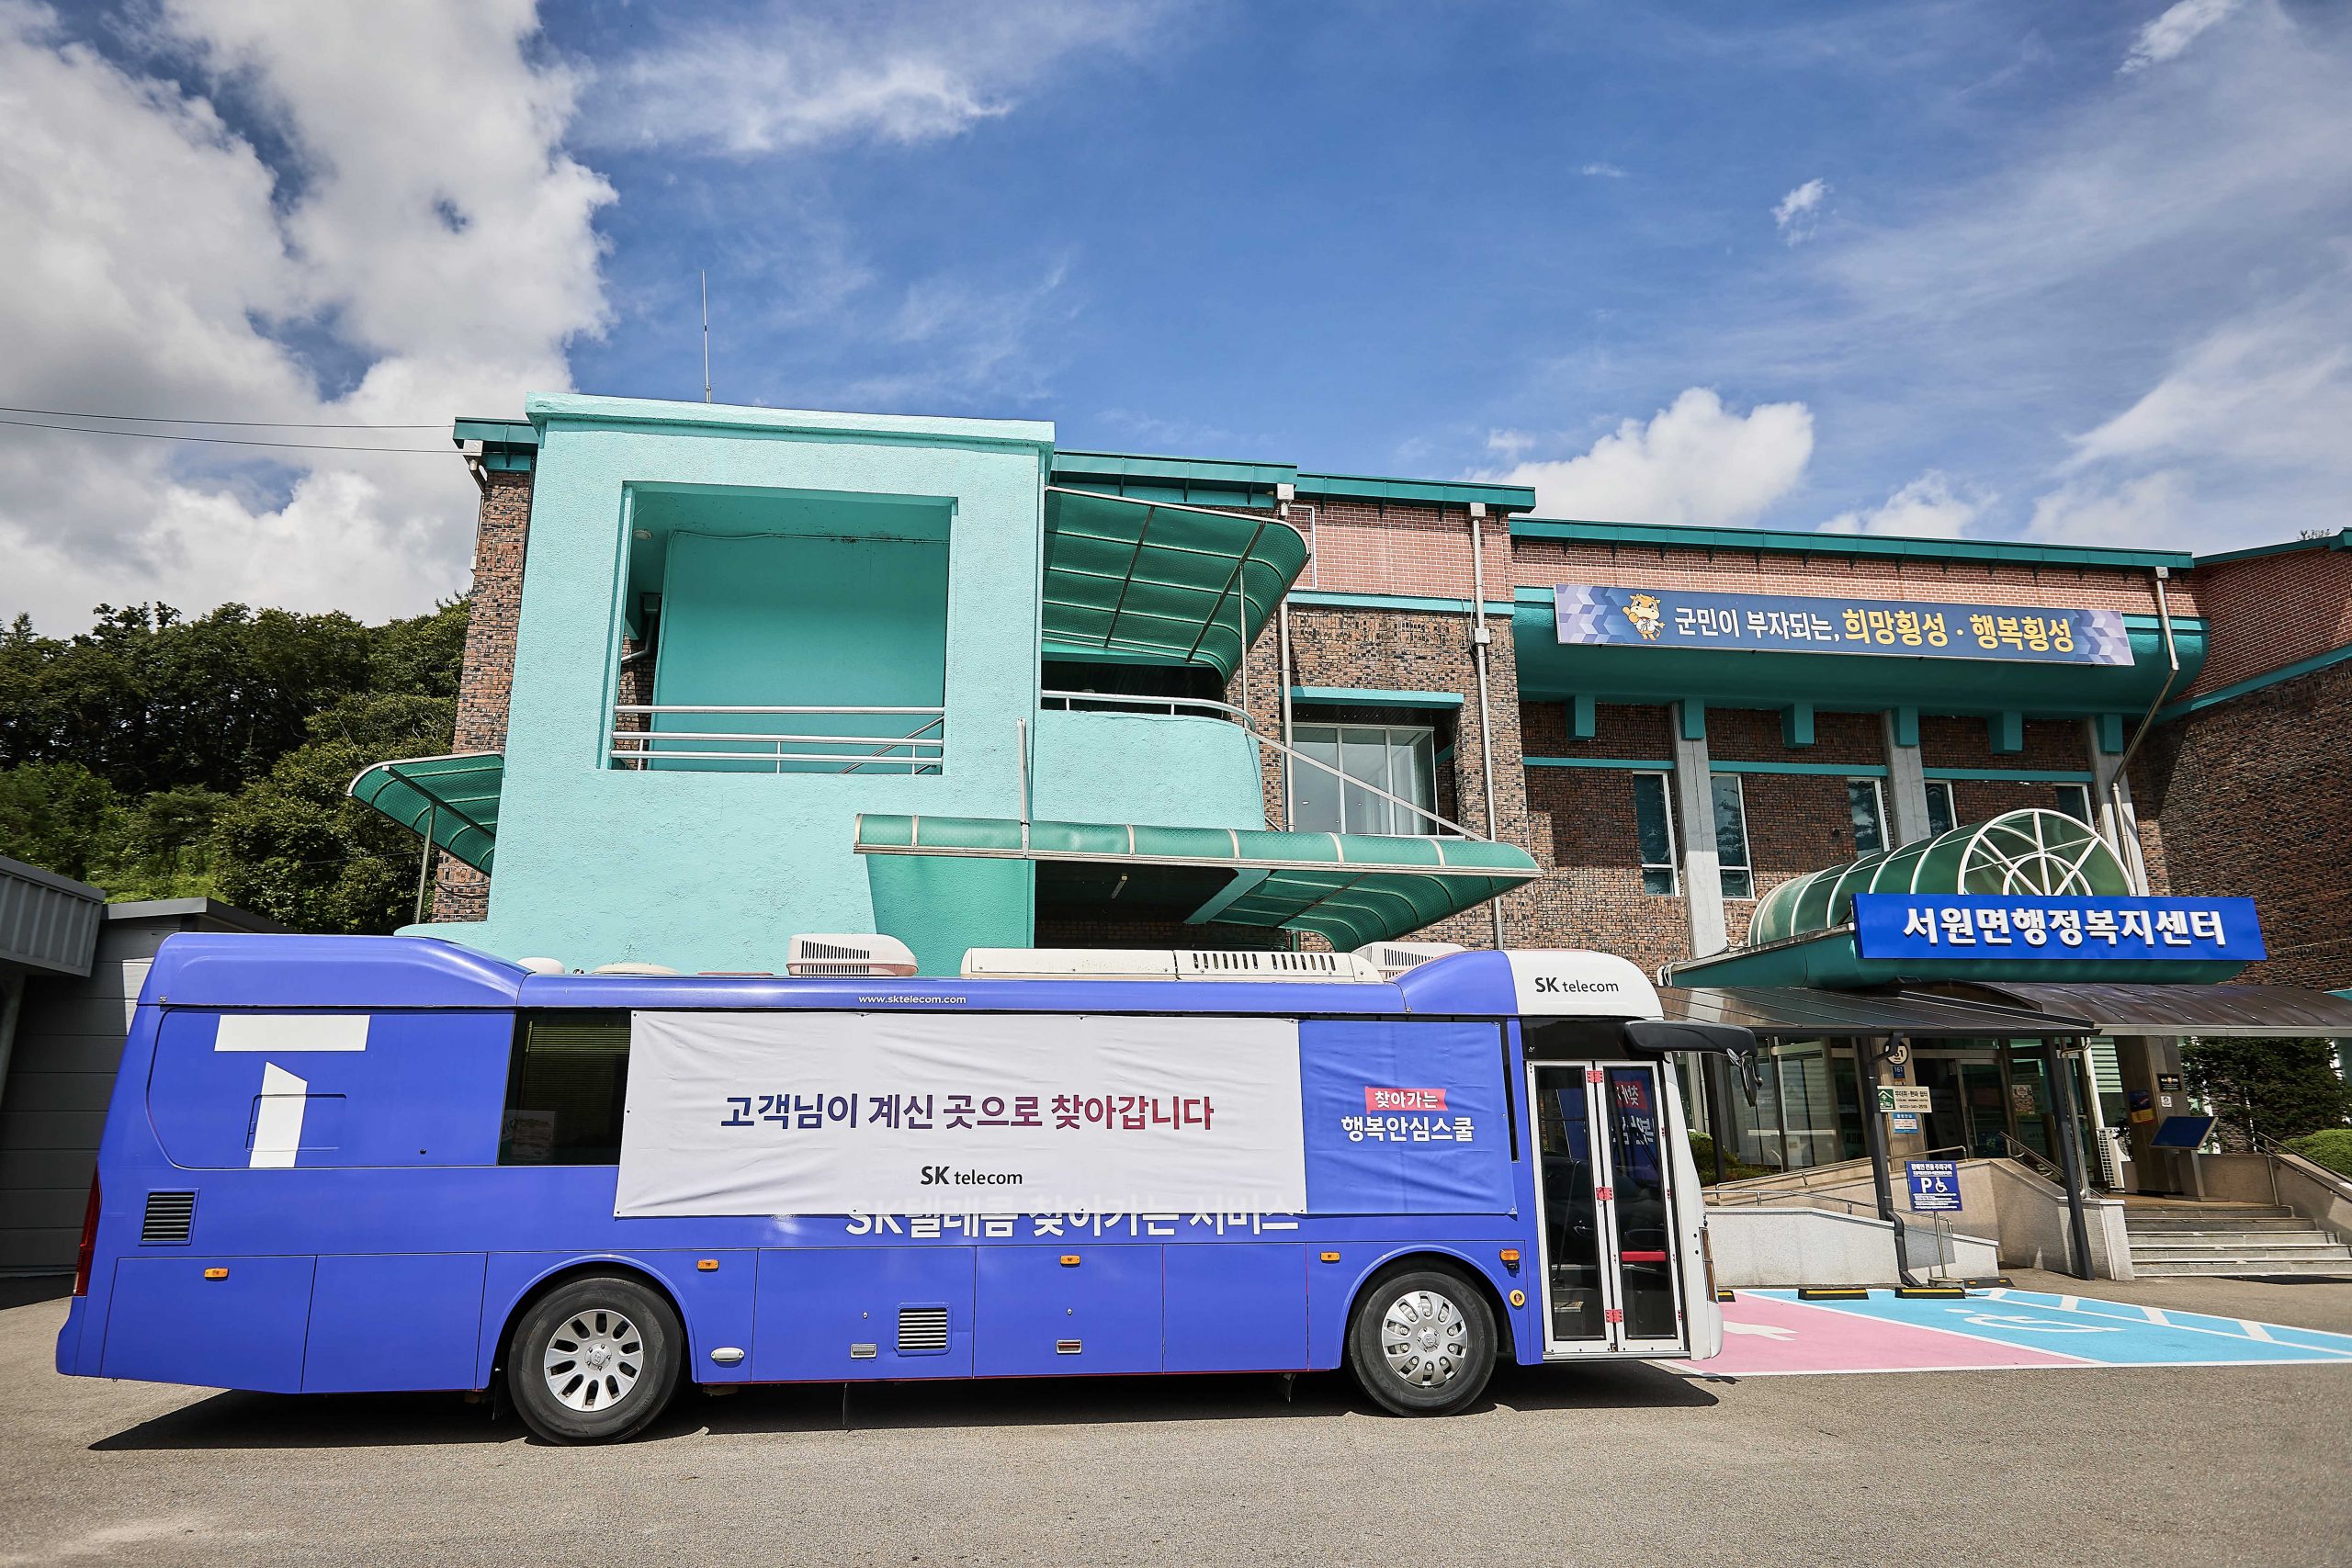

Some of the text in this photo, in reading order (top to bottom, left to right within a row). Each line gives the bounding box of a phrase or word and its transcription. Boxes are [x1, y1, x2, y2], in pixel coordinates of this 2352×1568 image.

[1674, 607, 1740, 638] 군민이
[1746, 610, 1840, 642] 부자되는,
[1841, 608, 1949, 648] 희망횡성
[1969, 613, 2075, 653] 행복횡성
[1903, 908, 2226, 947] 서원면행정복지센터
[1534, 976, 1620, 993] SK telecom
[858, 995, 967, 1004] www.sktelecom.com
[1374, 1090, 1439, 1109] 찾아가는
[721, 1092, 1214, 1131] 고객님이 계신 곳으로 찾아갑니다
[1340, 1116, 1475, 1142] 행복안심스쿨
[920, 1165, 1023, 1186] SK telecom
[1920, 1178, 1932, 1193] P
